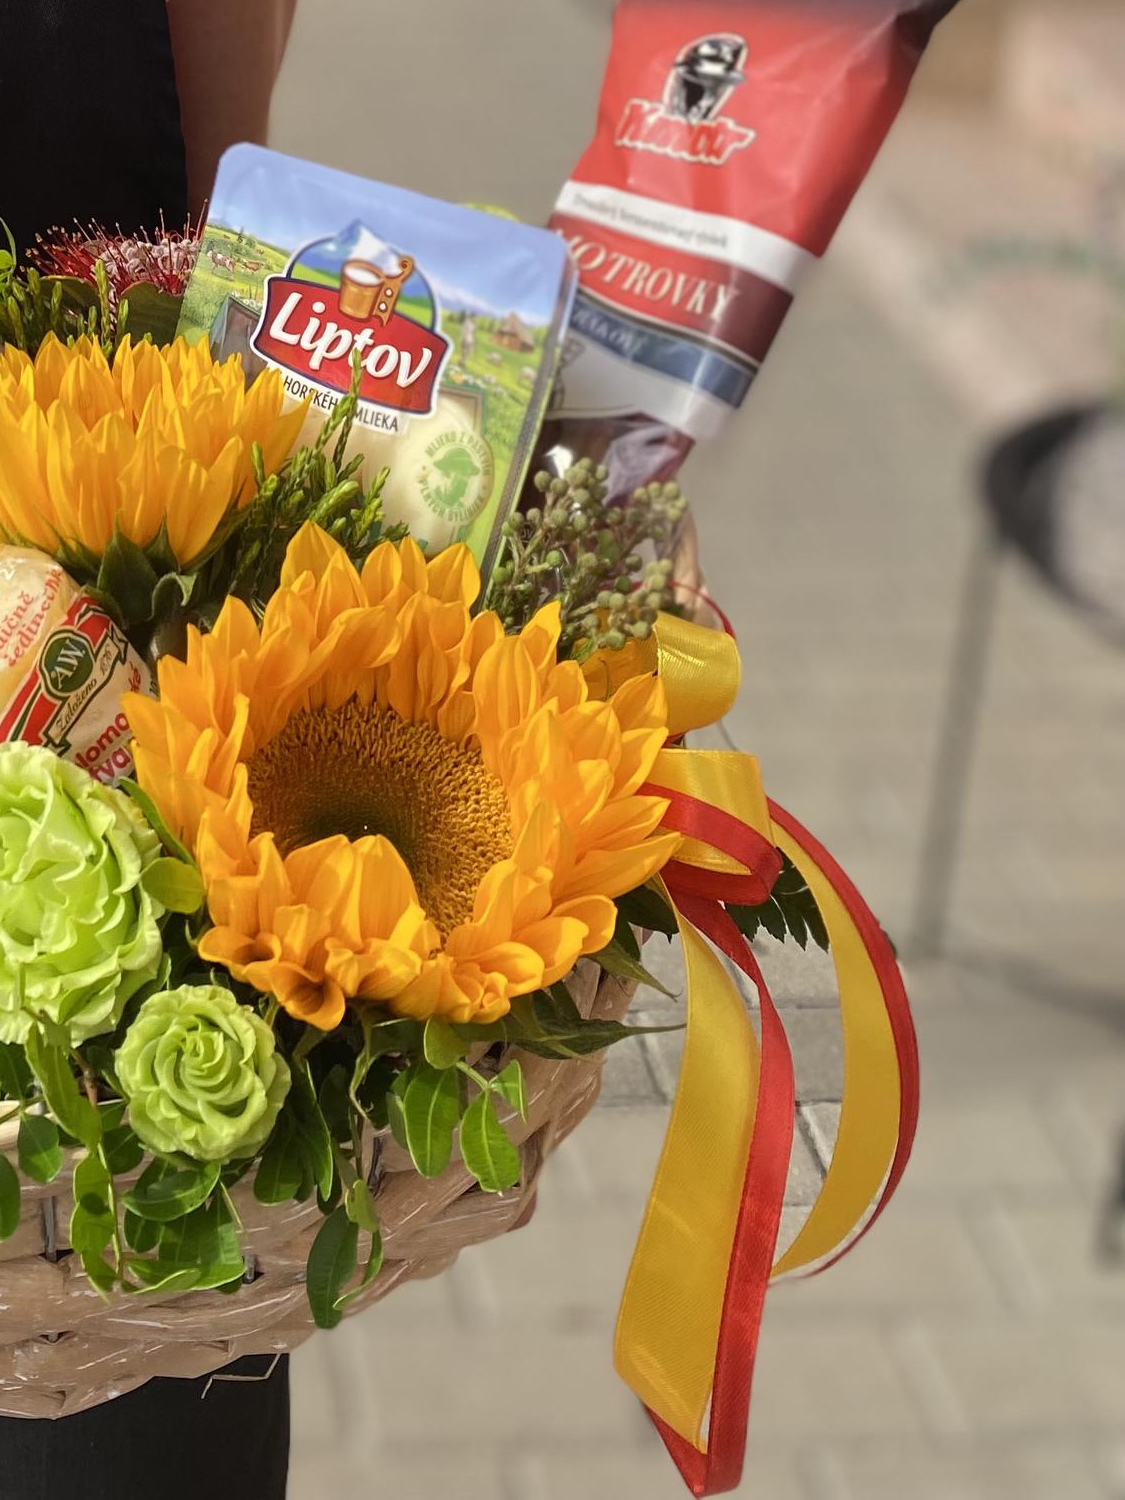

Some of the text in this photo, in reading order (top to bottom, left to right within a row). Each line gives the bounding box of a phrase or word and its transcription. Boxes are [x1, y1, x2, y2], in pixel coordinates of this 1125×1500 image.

[269, 291, 433, 389] Liptov
[283, 374, 399, 433] HORKÉH MLIEKA
